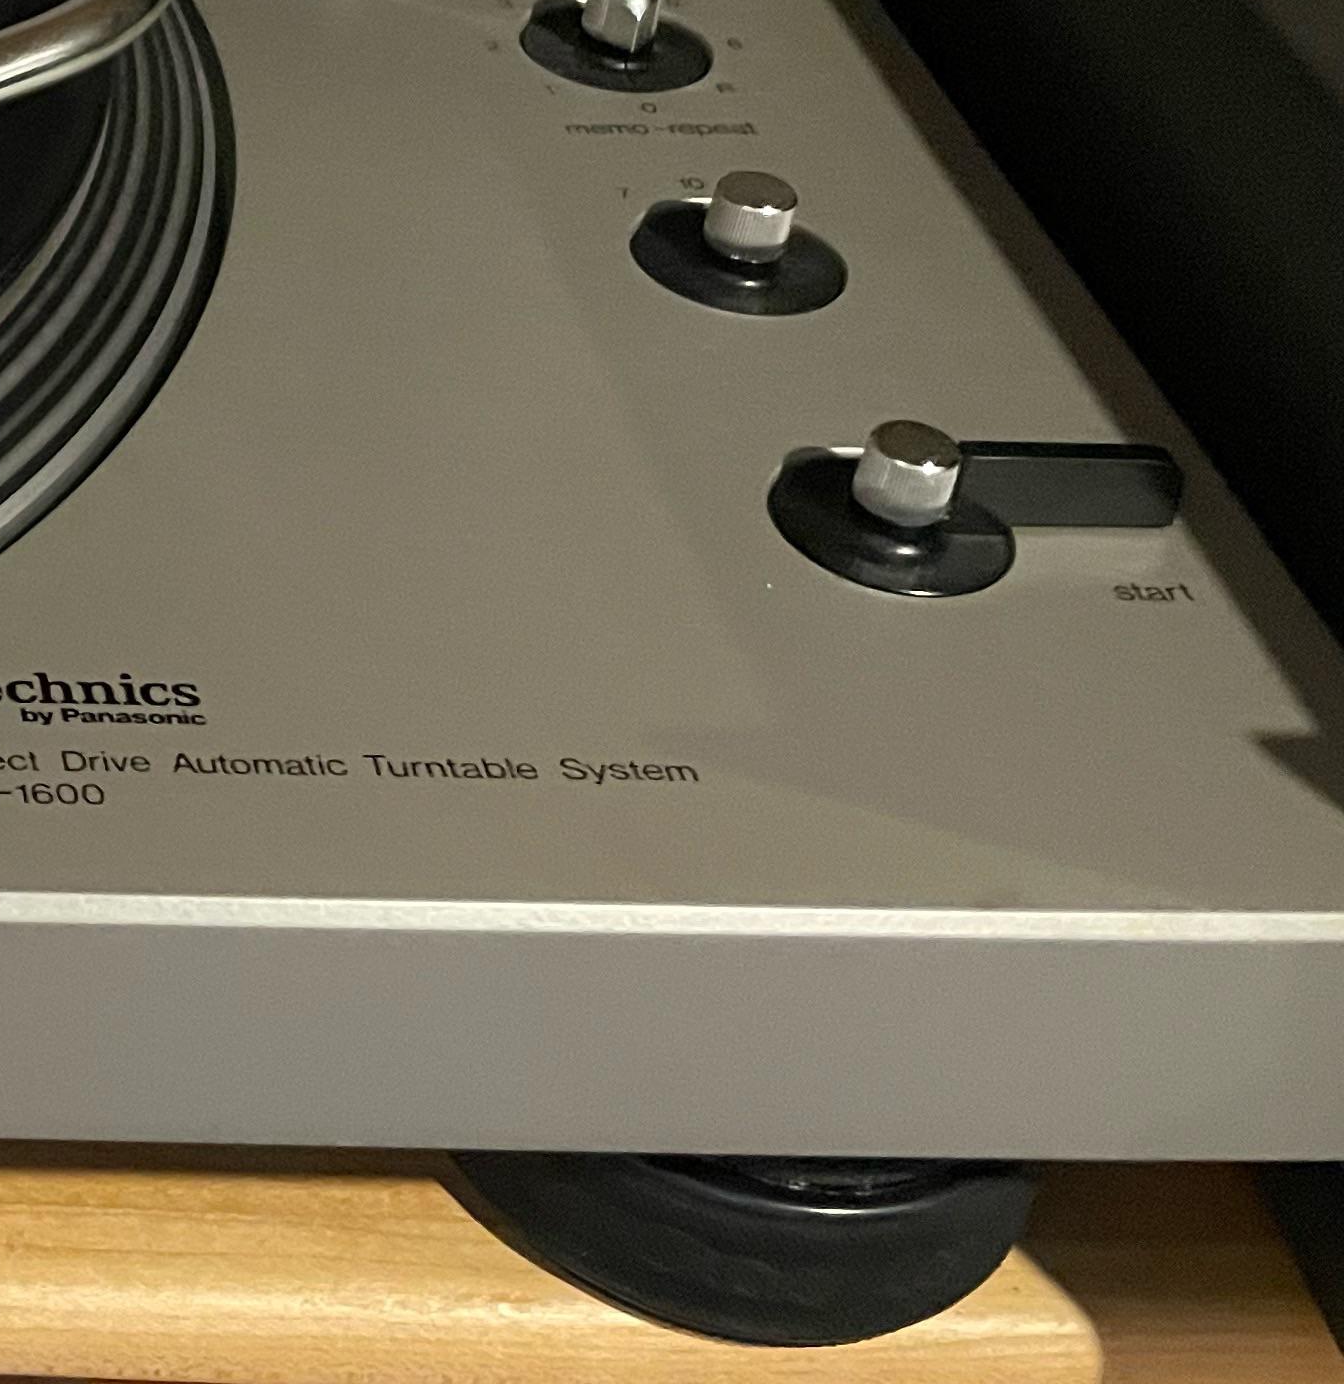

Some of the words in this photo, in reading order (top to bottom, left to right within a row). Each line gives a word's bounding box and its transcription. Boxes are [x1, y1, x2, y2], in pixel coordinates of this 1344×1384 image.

[1112, 582, 1196, 602] start
[20, 707, 54, 725] by
[60, 707, 207, 726] Panasonic
[60, 749, 152, 773] Drive
[172, 752, 349, 778] Automatic
[363, 753, 539, 781] Turntable
[560, 757, 699, 785] System
